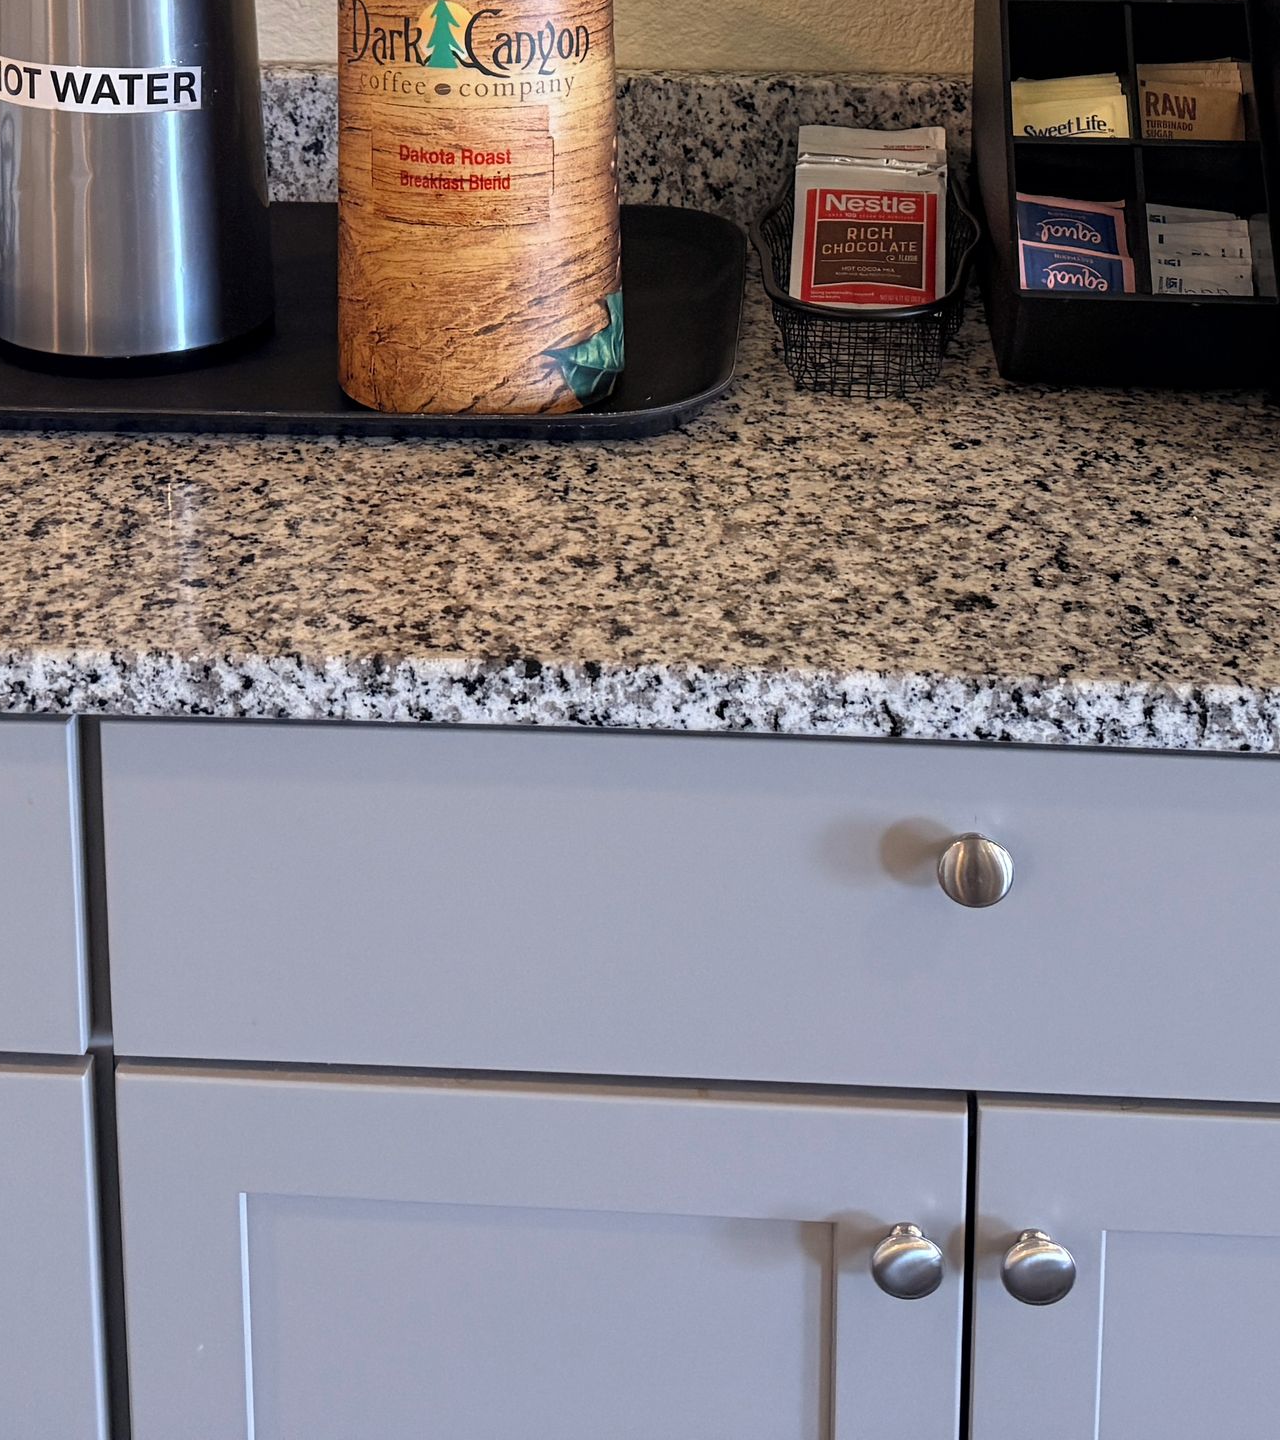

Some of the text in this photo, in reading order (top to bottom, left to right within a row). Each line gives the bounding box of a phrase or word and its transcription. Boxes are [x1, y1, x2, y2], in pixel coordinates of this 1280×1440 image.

[455, 8, 590, 78] Canyon
[50, 71, 197, 105] WATER
[360, 70, 575, 102] coffee company
[1145, 91, 1196, 120] RAW
[1024, 114, 1107, 137] Sweet Life
[1146, 119, 1193, 131] TURBINADO
[1146, 129, 1173, 139] SUGAR
[399, 144, 512, 165] Dakota Roast
[400, 170, 511, 191] Breakfast Blend
[847, 227, 893, 240] RICH
[1037, 219, 1101, 244] equal
[822, 241, 918, 255] CHOCOLATE
[1043, 264, 1108, 291] equal
